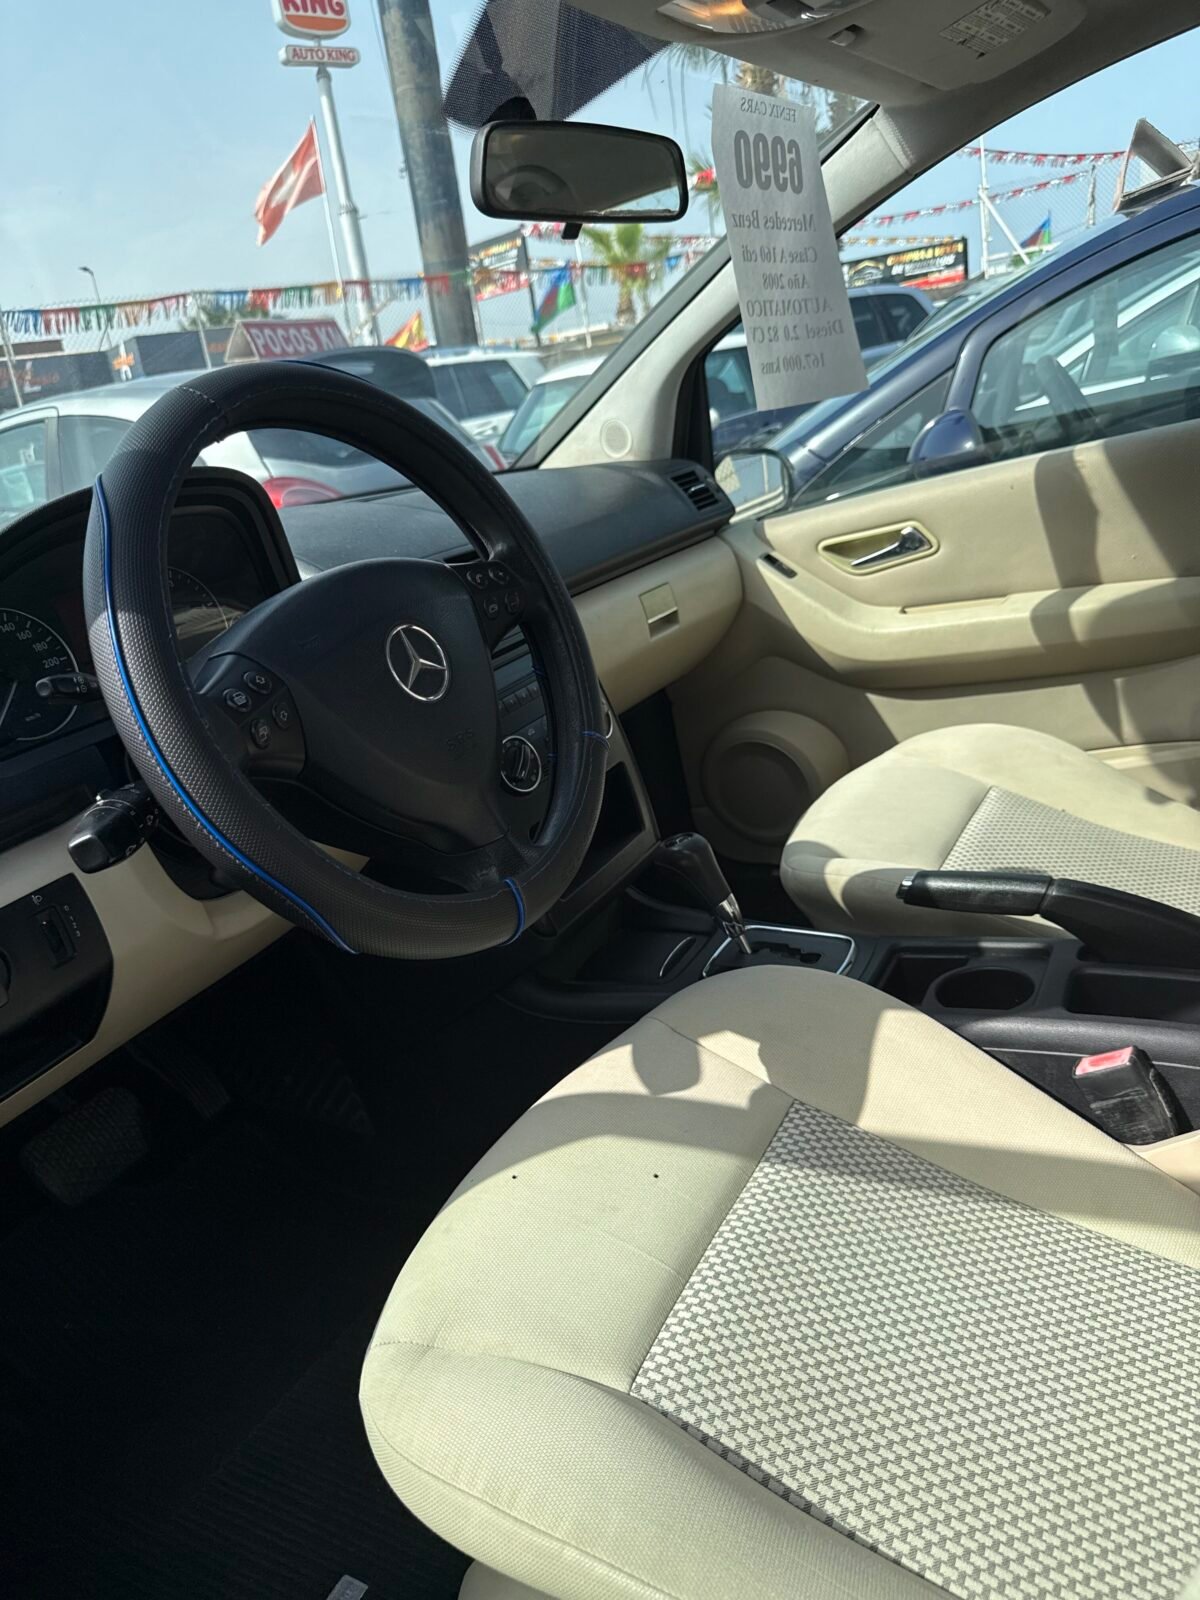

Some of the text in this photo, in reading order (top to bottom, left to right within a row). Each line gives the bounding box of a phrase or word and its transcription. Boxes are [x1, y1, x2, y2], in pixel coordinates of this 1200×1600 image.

[292, 47, 356, 61] AUTO KING
[251, 326, 318, 355] POCOS
[16, 630, 33, 641] 160
[32, 641, 49, 653] 180
[42, 656, 60, 669] 200
